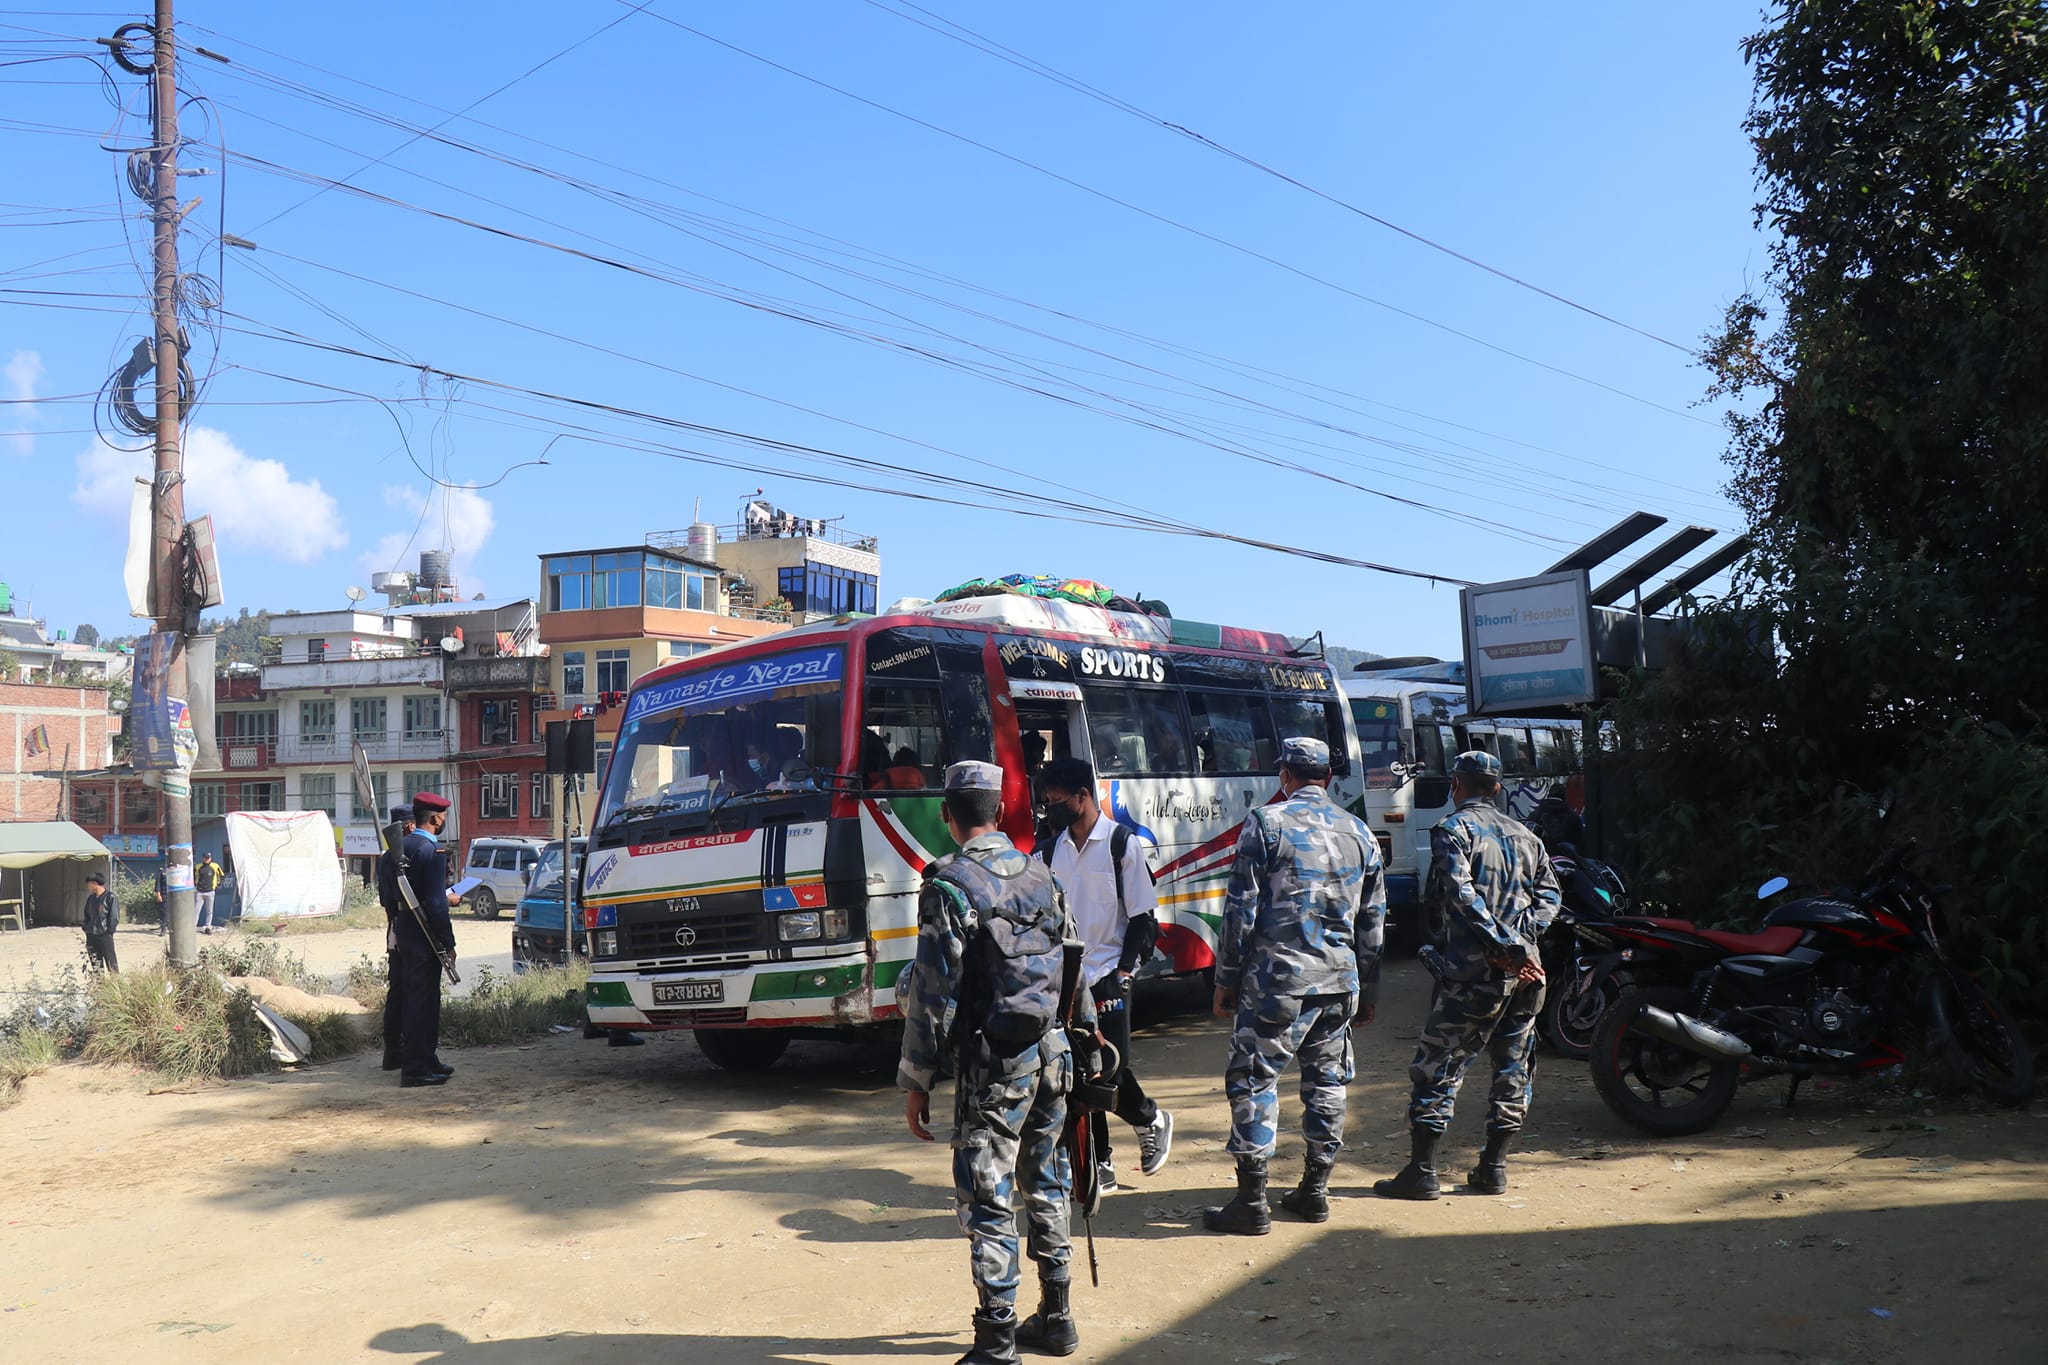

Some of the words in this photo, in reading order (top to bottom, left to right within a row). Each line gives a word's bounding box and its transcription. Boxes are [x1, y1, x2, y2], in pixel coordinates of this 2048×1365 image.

[1522, 605, 1575, 624] Hospital
[1080, 647, 1165, 683] SPORTS
[632, 669, 735, 713] Namaste
[741, 652, 836, 685] Nepal
[638, 839, 690, 855] दोलखा
[695, 832, 737, 846] दर्शन
[595, 854, 618, 890] NIKE
[666, 896, 700, 913] TATA
